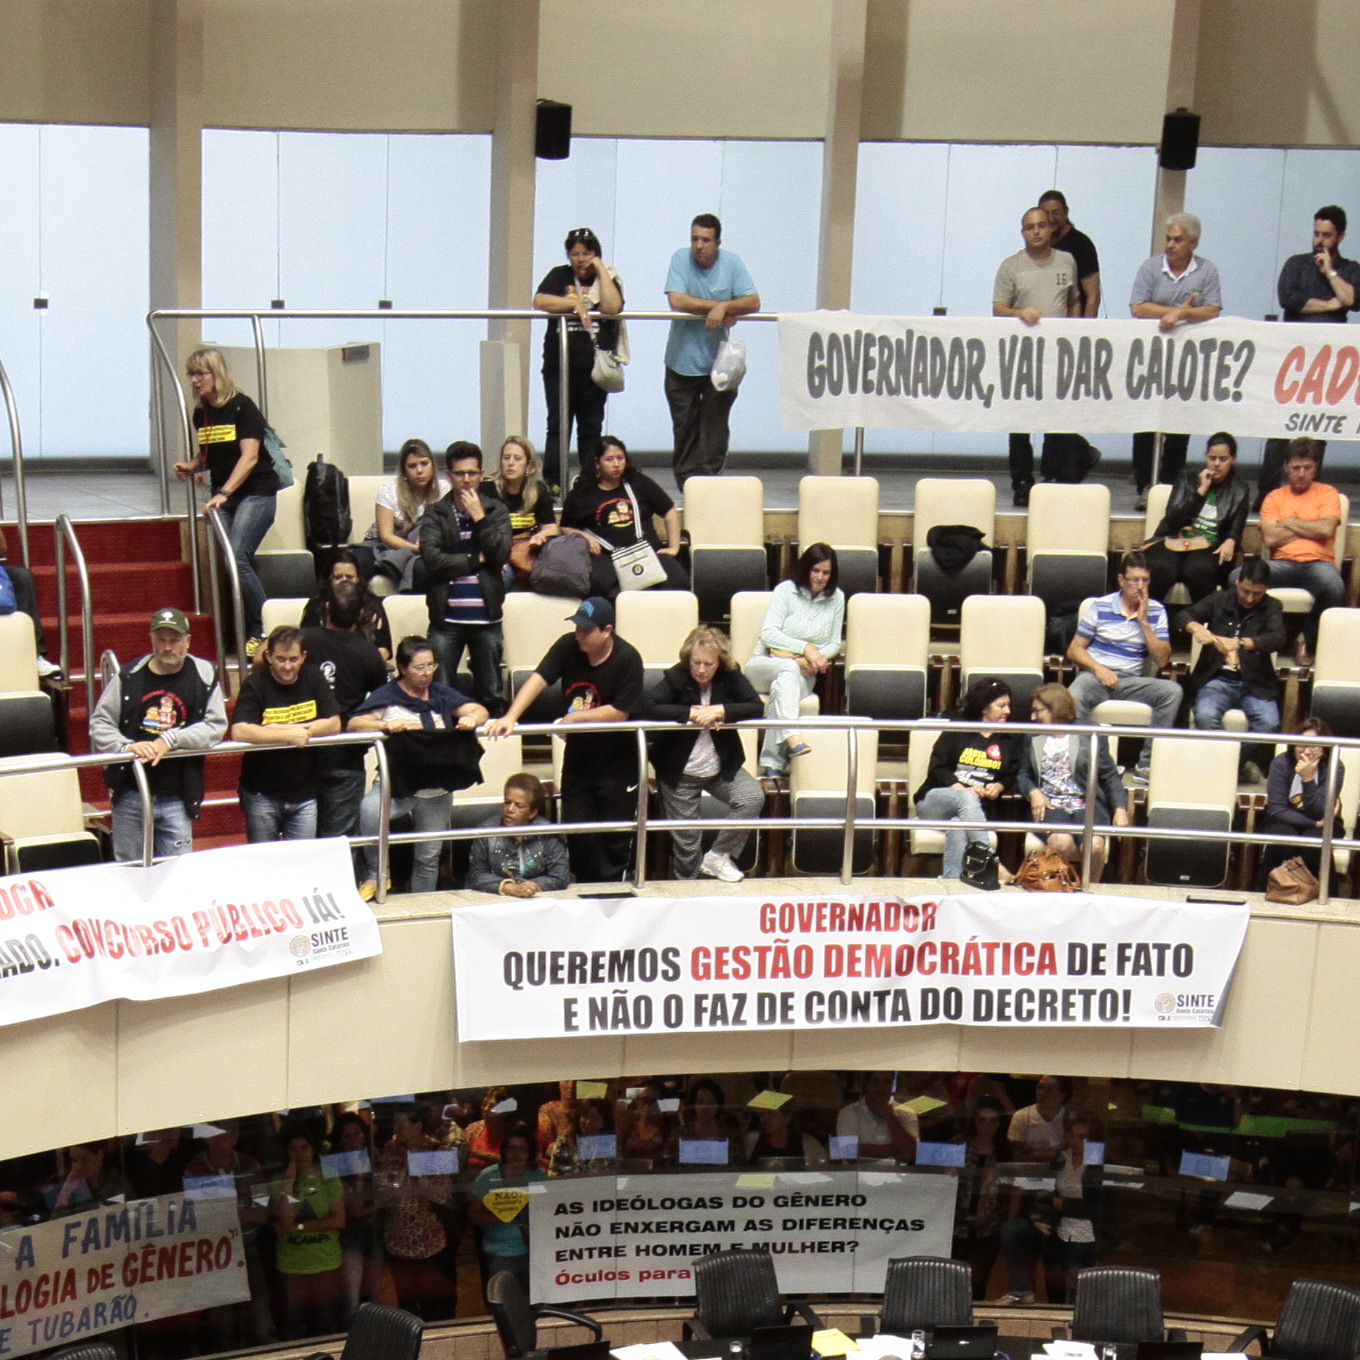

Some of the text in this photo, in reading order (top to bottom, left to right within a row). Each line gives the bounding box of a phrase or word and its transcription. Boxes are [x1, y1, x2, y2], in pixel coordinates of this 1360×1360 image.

[807, 329, 1255, 408] GOVERNADOR, VAI DAR CALOTE?
[1285, 413, 1347, 434] SINTE
[55, 914, 193, 965] CONCURSO
[192, 898, 305, 948] PÚBLICO
[301, 887, 347, 925] JÁ!
[759, 902, 937, 934] GOVERNADOR
[311, 927, 349, 947] SINTE
[503, 935, 1194, 991] QUEREMOS GESTÃO DEMOCRÁTICA DE FATO
[563, 986, 1133, 1032] E NÃO O FAZ DE CONTA DO DECRETO!
[1177, 994, 1215, 1007] SINTE
[554, 1191, 867, 1216] AS IDEÓLOGAS DO GÊNERO
[15, 1234, 35, 1272] A
[62, 1200, 197, 1260] FAMÍLIA
[555, 1217, 925, 1240] NÃO ENXERGAM AS DIFERENÇAS
[555, 1244, 627, 1263] ENTRE
[635, 1241, 721, 1258] HOMEM
[752, 1240, 860, 1254] MULHER?
[87, 1263, 115, 1294] DE
[555, 1267, 692, 1287] Óculos para
